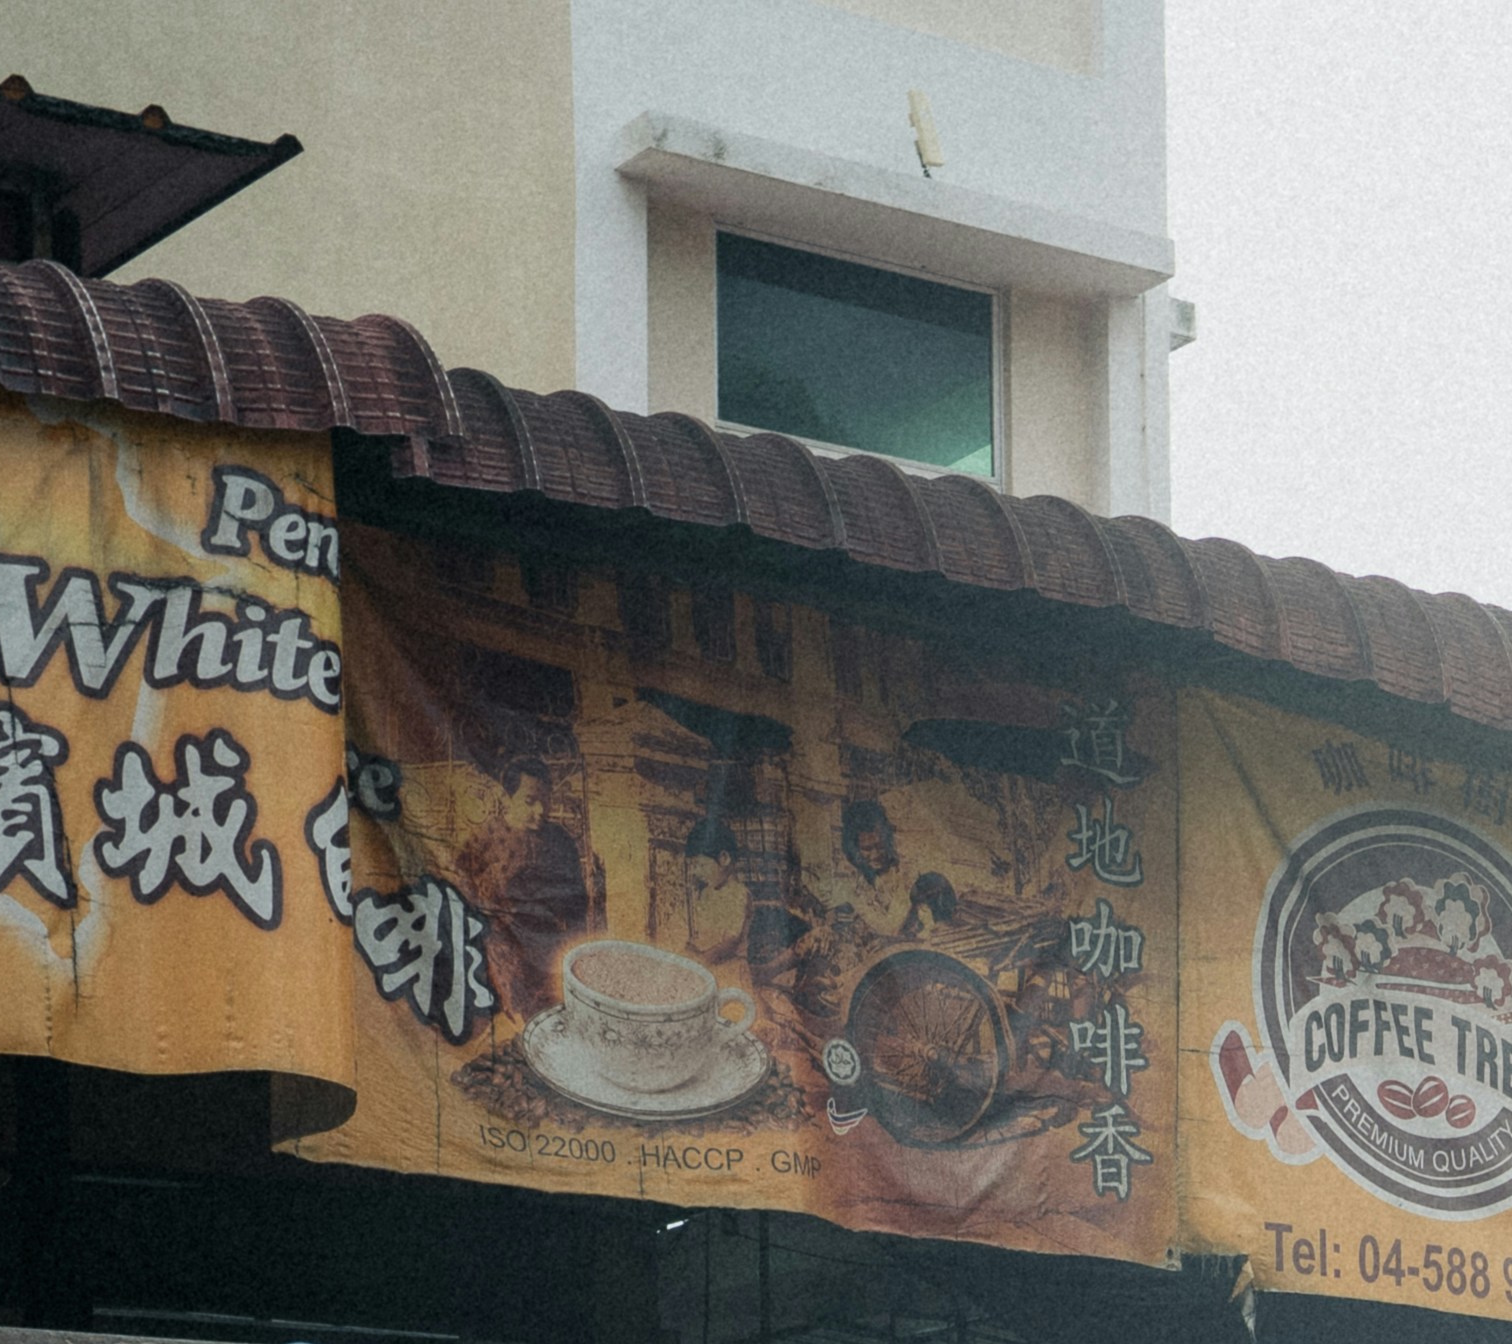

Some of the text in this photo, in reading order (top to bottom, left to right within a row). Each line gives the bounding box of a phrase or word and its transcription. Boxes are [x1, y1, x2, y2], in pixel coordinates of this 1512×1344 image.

[210, 470, 340, 582] Pen
[1060, 698, 1152, 1200] 道地咖啡香
[1304, 1000, 1434, 1073] COFFEE
[478, 1125, 823, 1181] ISO 22000 HACCP GMP
[1331, 1079, 1426, 1170] PREMIUM
[1265, 1222, 1343, 1278] Tel:
[1358, 1234, 1490, 1298] 04-588
